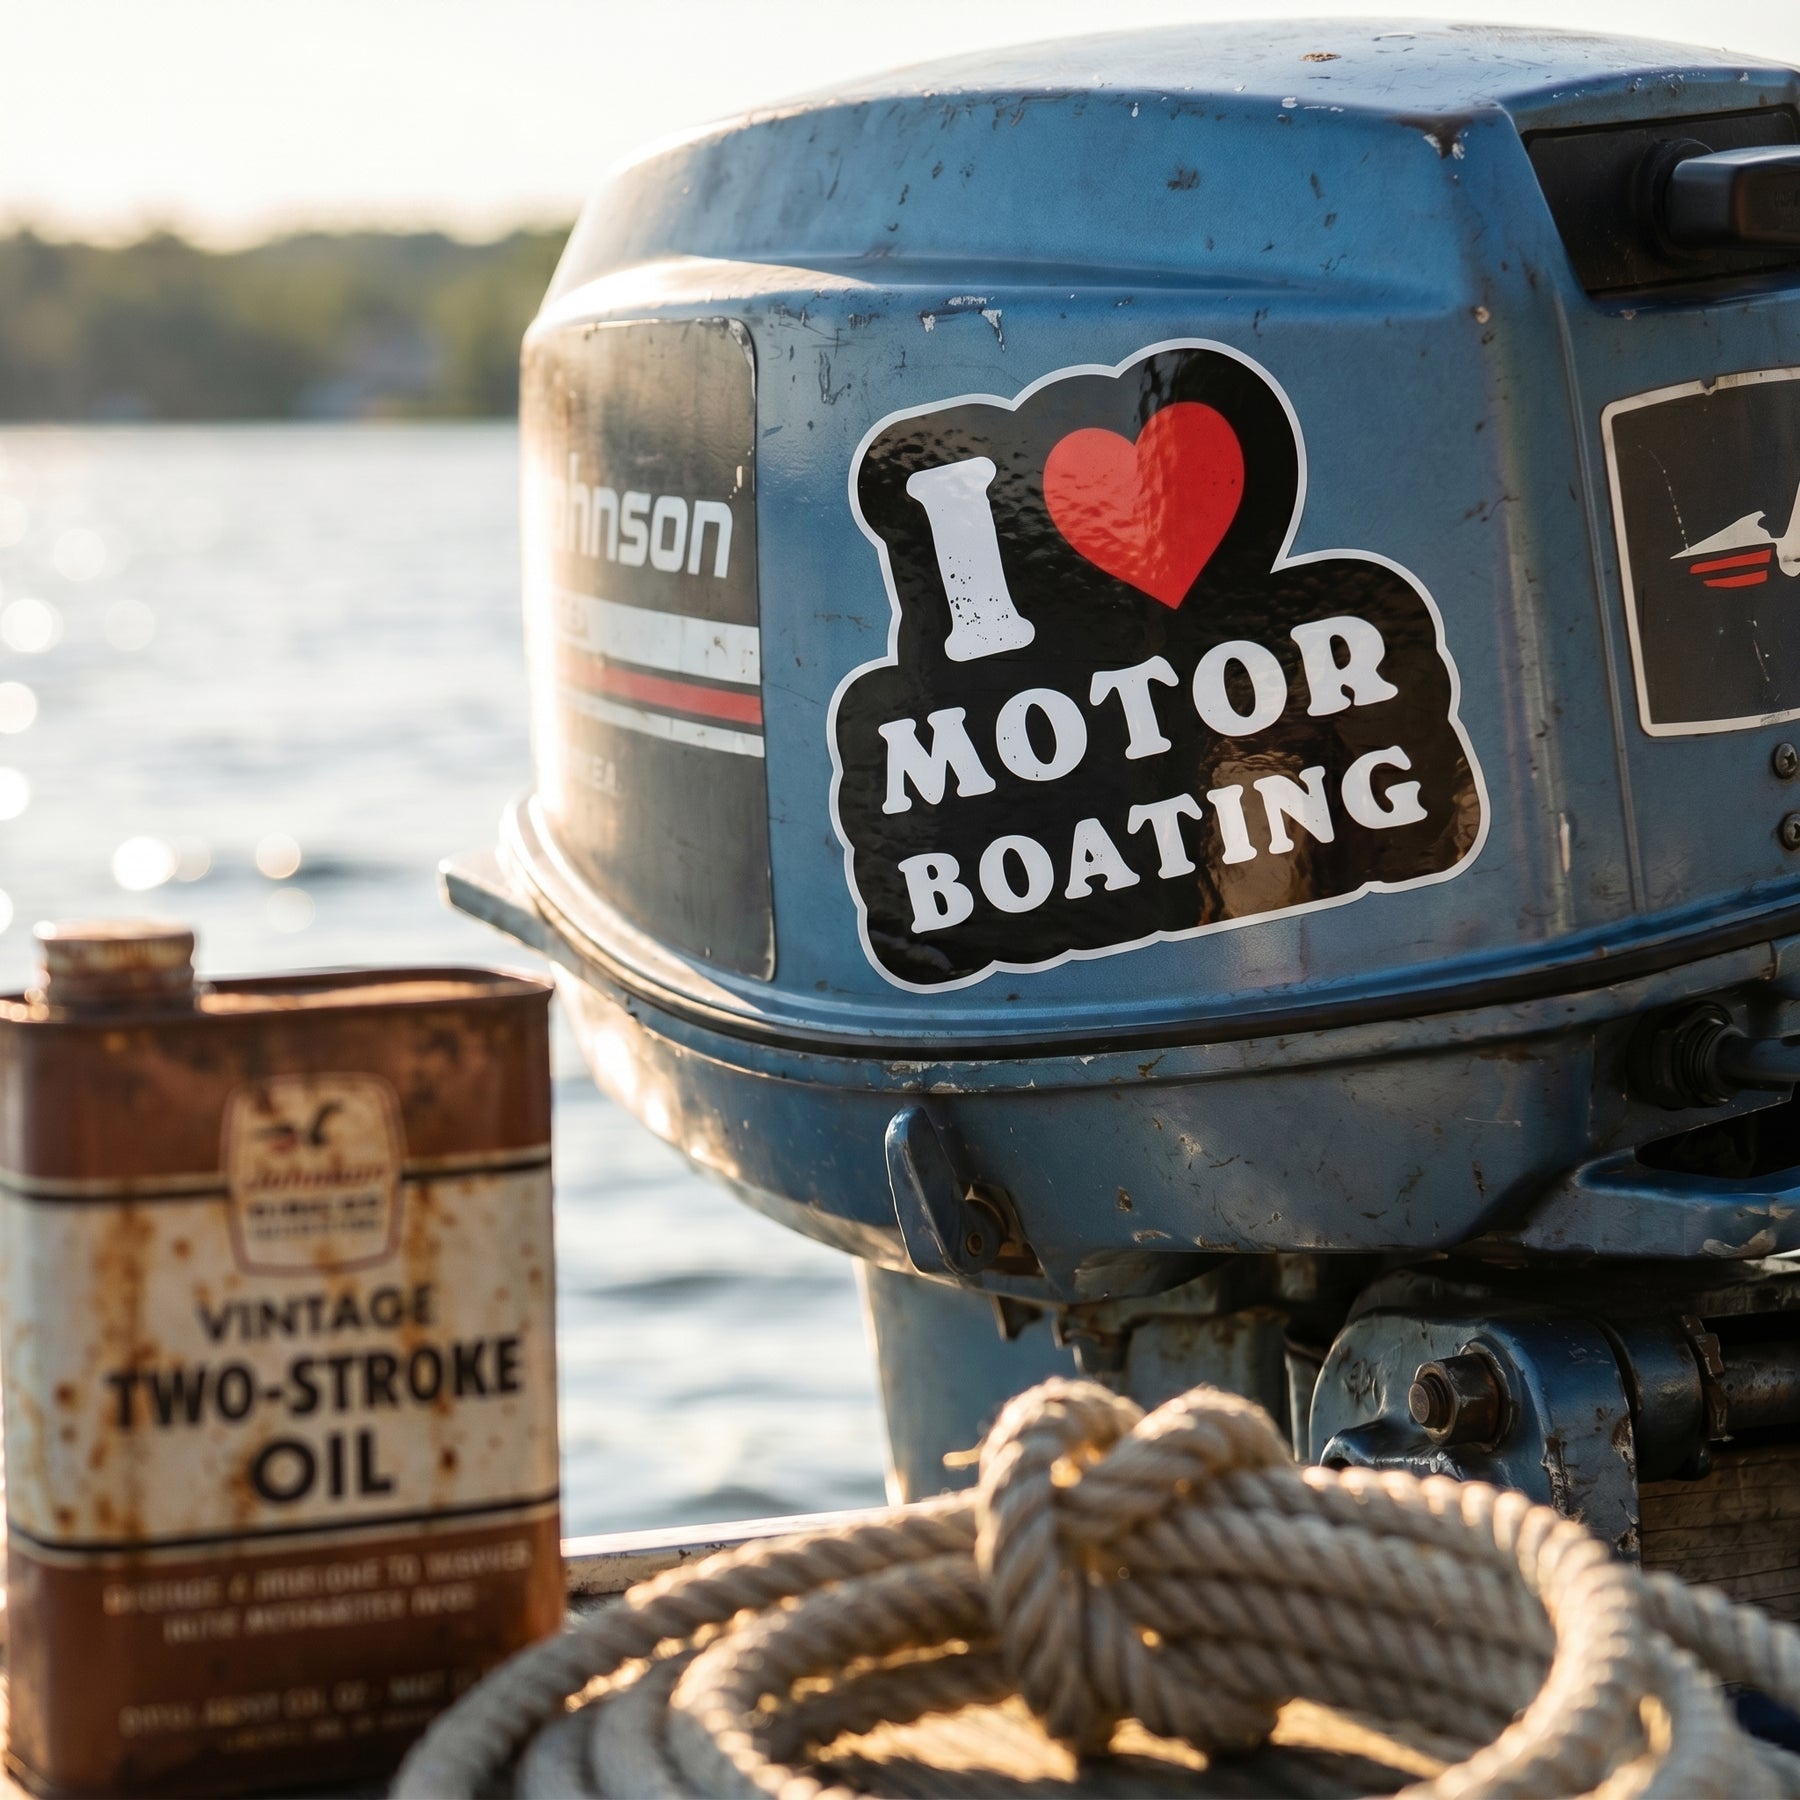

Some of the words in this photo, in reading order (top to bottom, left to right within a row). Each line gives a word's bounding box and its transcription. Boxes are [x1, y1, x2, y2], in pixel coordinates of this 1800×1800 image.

[553, 452, 733, 578] hnson
[906, 456, 1036, 662] I
[877, 615, 1399, 816] MOTOR
[898, 745, 1428, 934] BOATING
[198, 1284, 438, 1345] VINTAGE
[105, 1336, 524, 1428] TWO-STROKE
[250, 1432, 394, 1505] OIL
